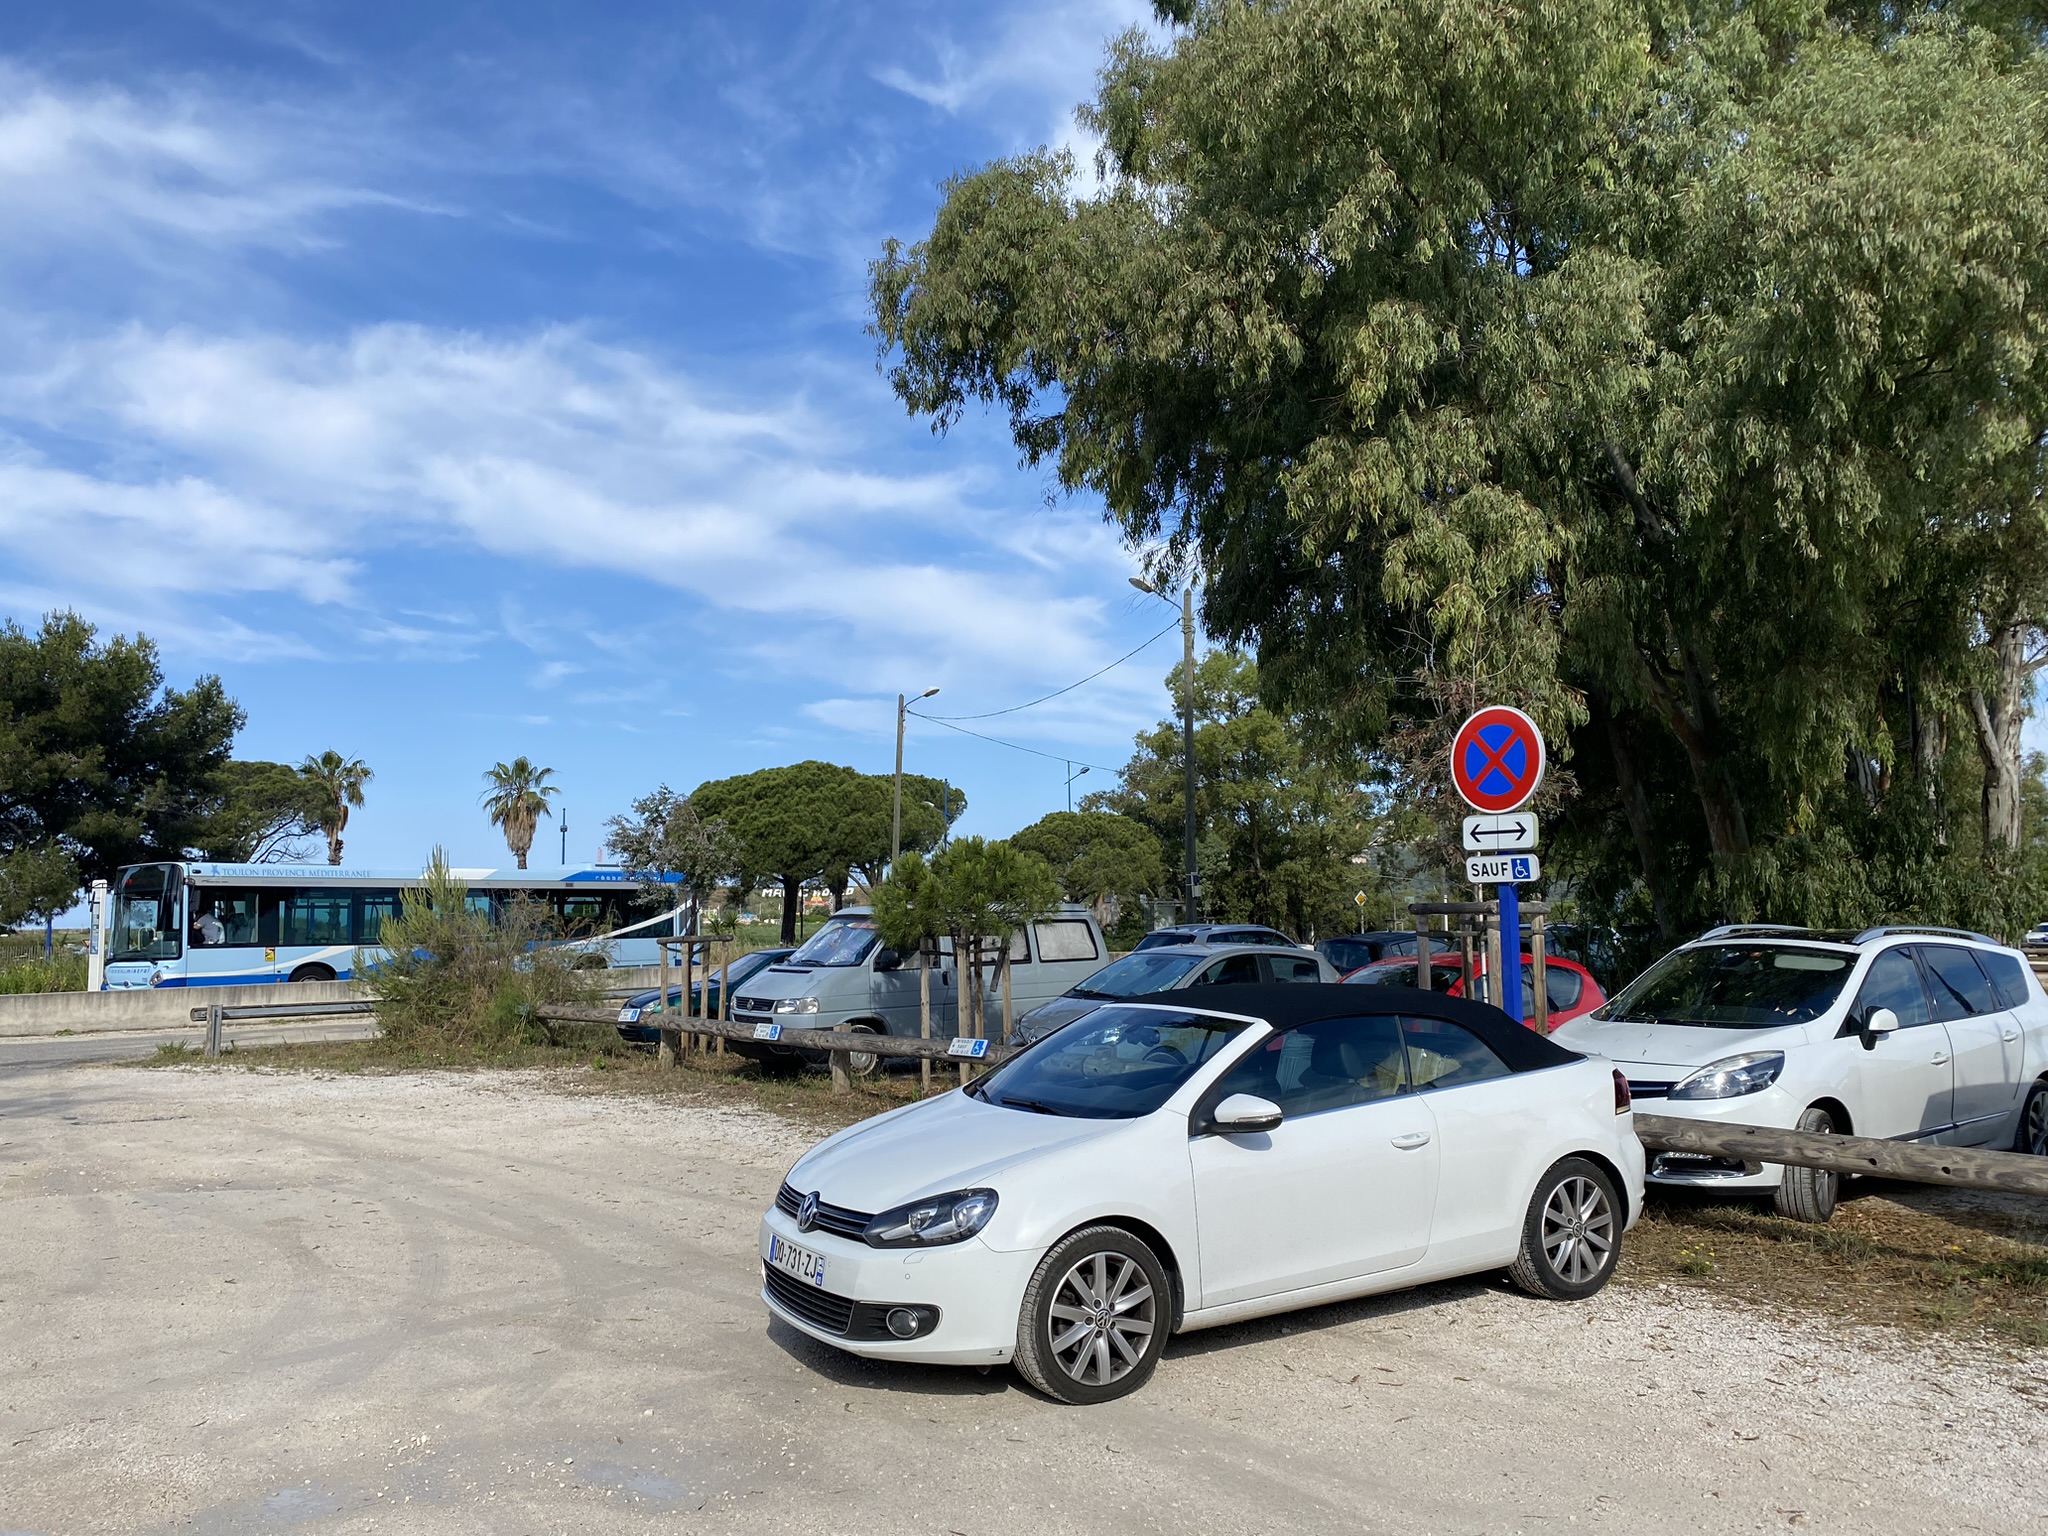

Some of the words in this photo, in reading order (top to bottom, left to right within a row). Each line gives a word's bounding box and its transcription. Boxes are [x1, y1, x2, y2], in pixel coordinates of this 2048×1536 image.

[222, 868, 259, 876] TOULON
[262, 868, 305, 877] PROVENCE
[1471, 862, 1508, 877] SAUF
